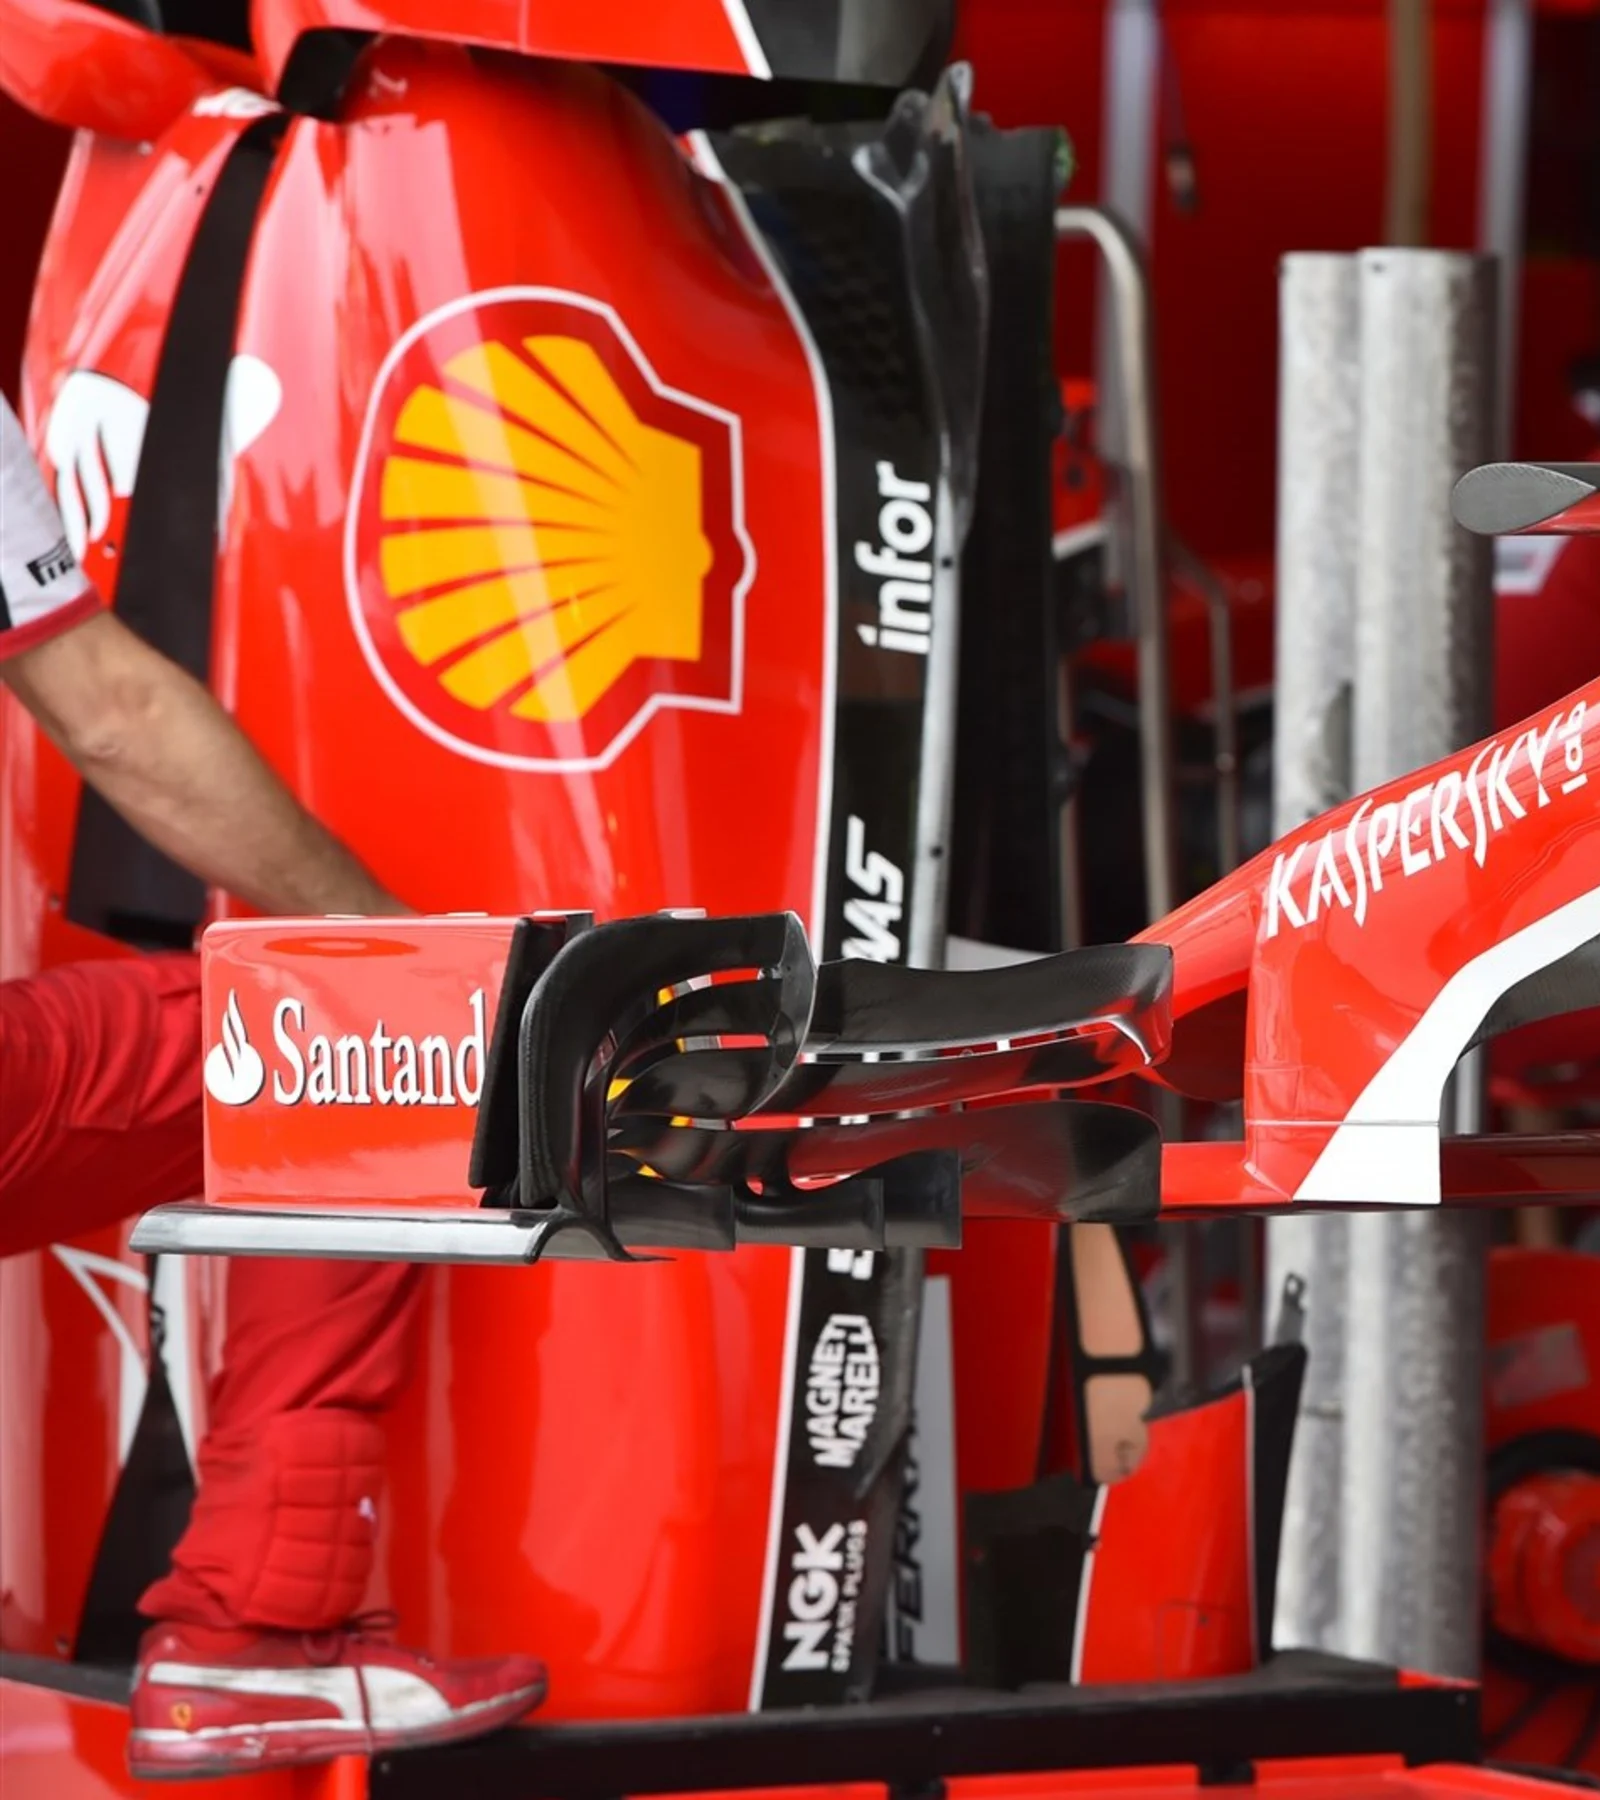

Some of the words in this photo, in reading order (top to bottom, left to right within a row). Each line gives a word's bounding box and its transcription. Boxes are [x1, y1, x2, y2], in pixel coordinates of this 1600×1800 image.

[854, 459, 933, 655] infor
[1266, 712, 1564, 938] KASPERSKY
[273, 987, 486, 1107] Santand
[805, 1314, 855, 1467] MAGNETI
[832, 1314, 880, 1467] MARELLI
[781, 1522, 846, 1671] NGK
